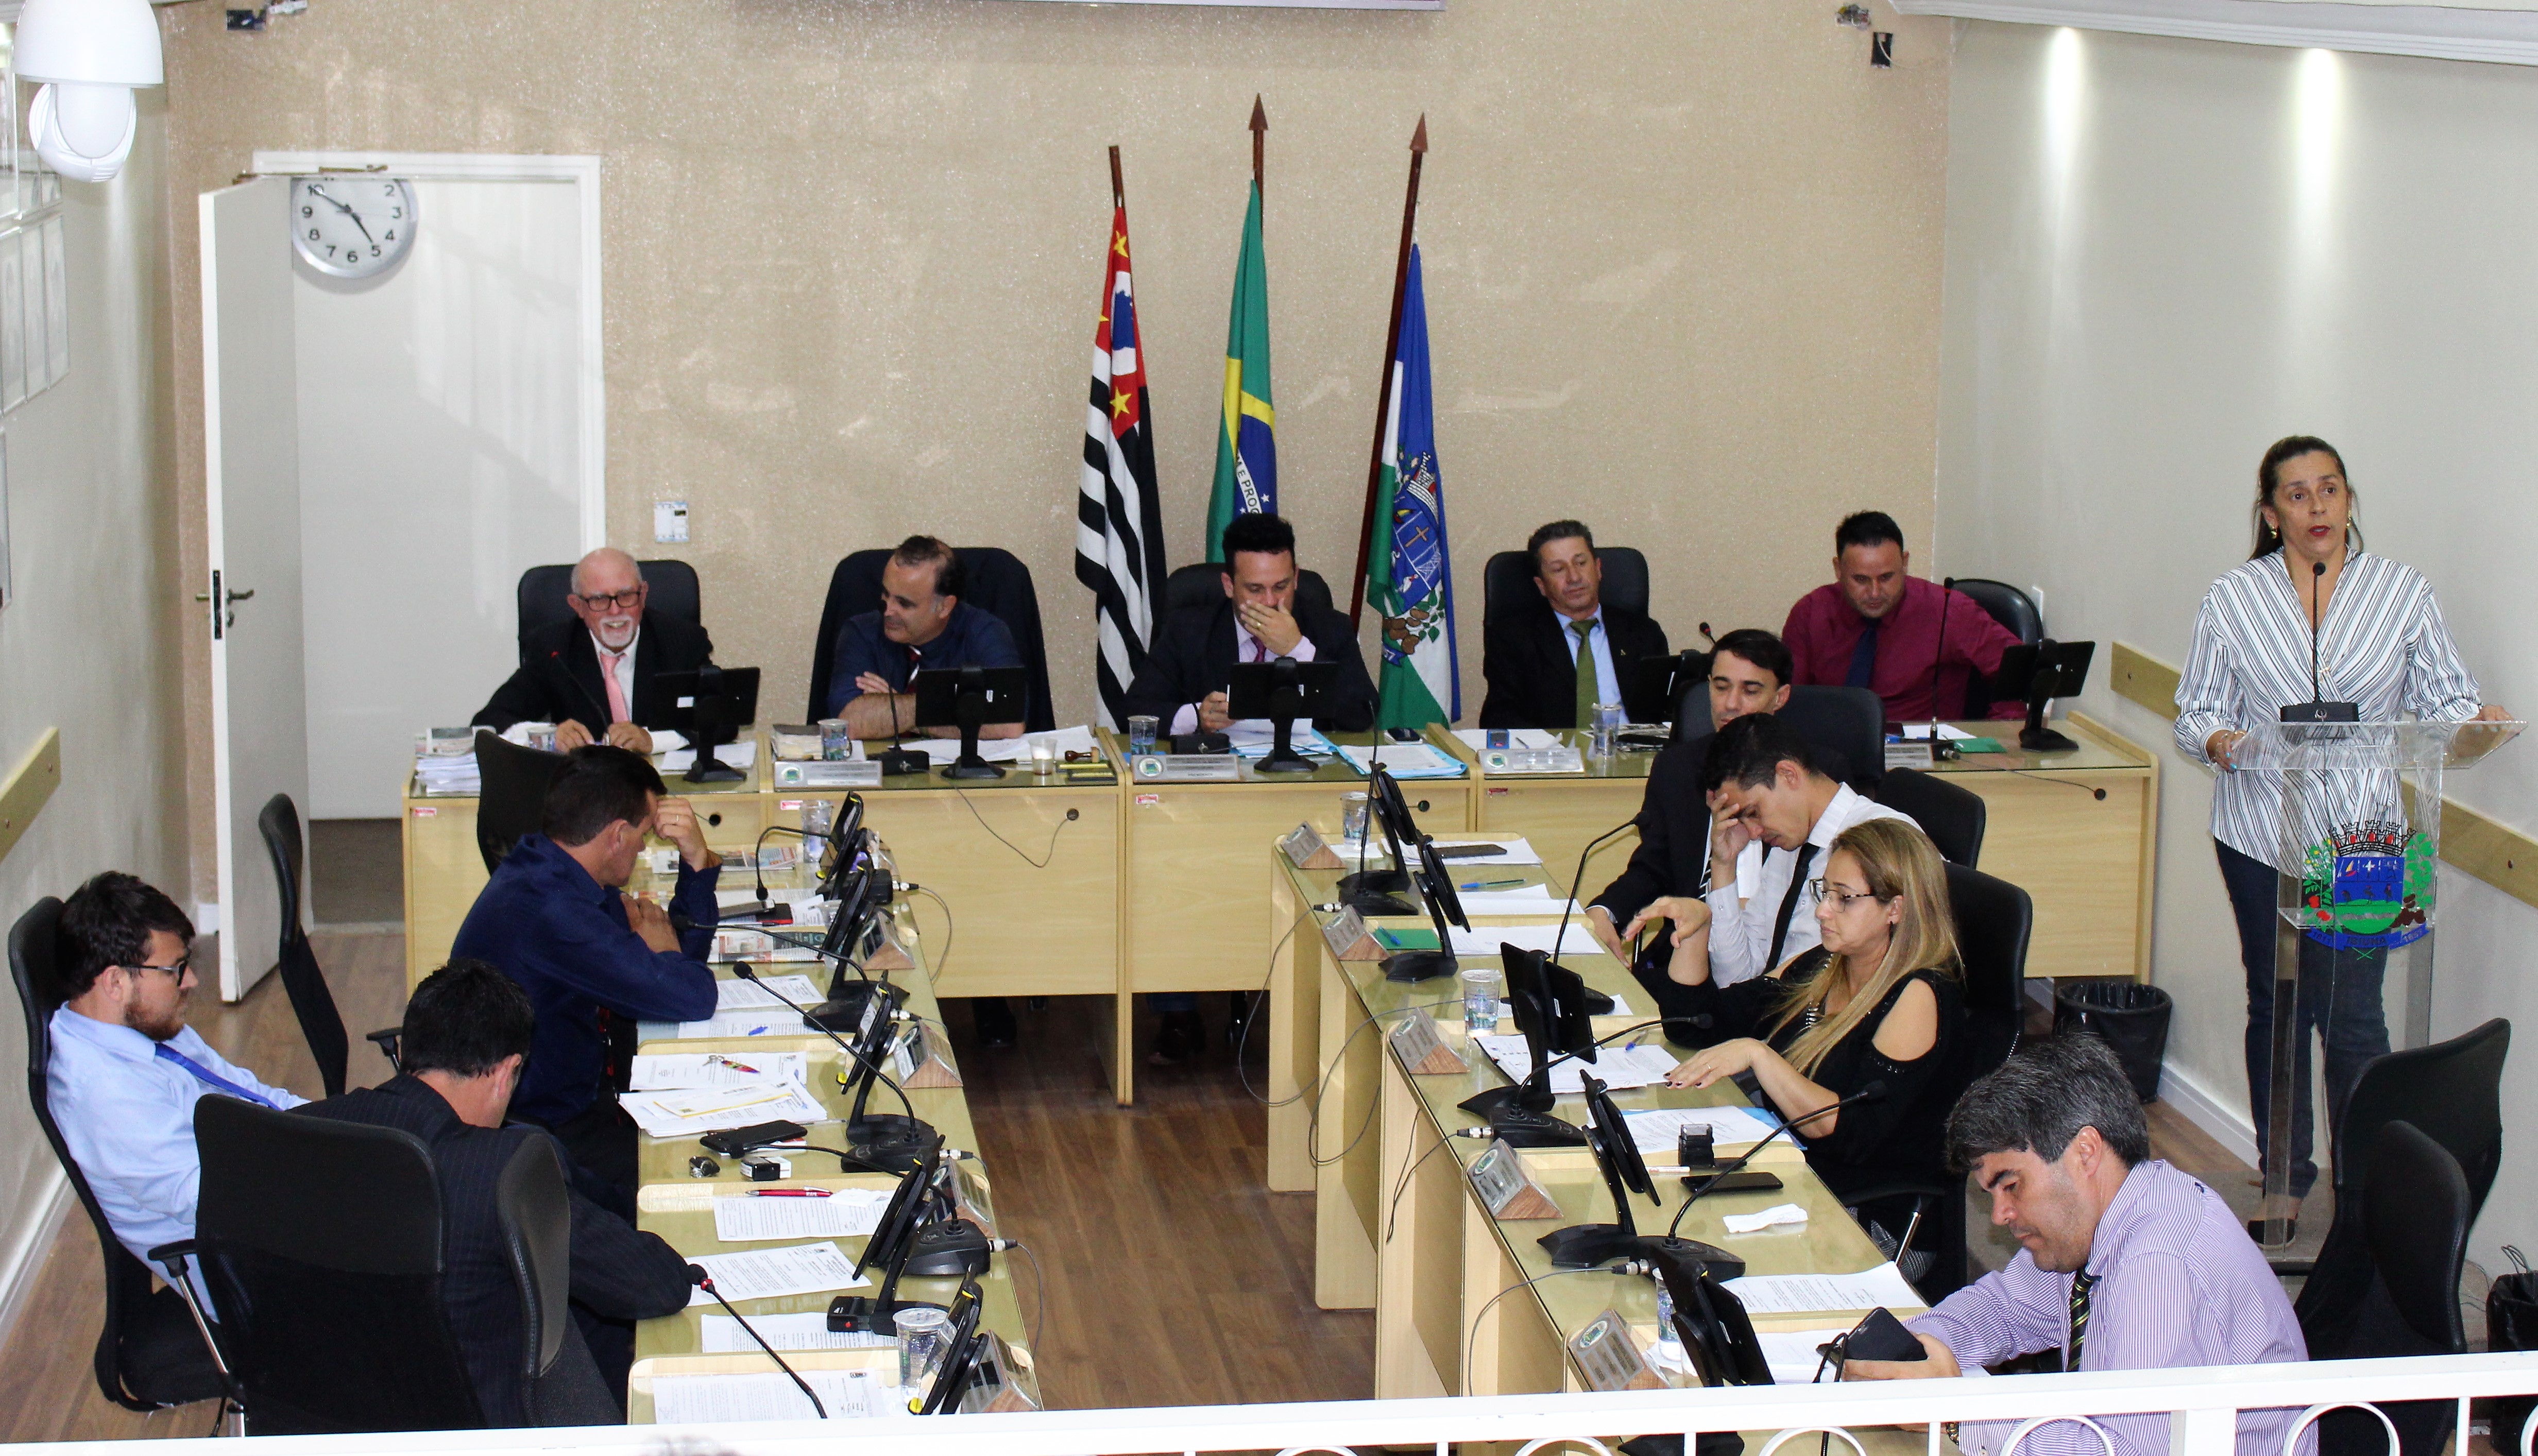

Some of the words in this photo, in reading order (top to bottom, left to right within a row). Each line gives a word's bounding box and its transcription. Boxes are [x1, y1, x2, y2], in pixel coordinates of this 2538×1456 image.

[385, 185, 394, 196] 2
[302, 206, 313, 218] 9
[392, 207, 401, 218] 3
[309, 229, 320, 241] 8
[385, 230, 395, 240] 4
[327, 245, 336, 257] 7
[371, 245, 381, 256] 5
[348, 251, 358, 262] 6
[1237, 470, 1246, 478] E
